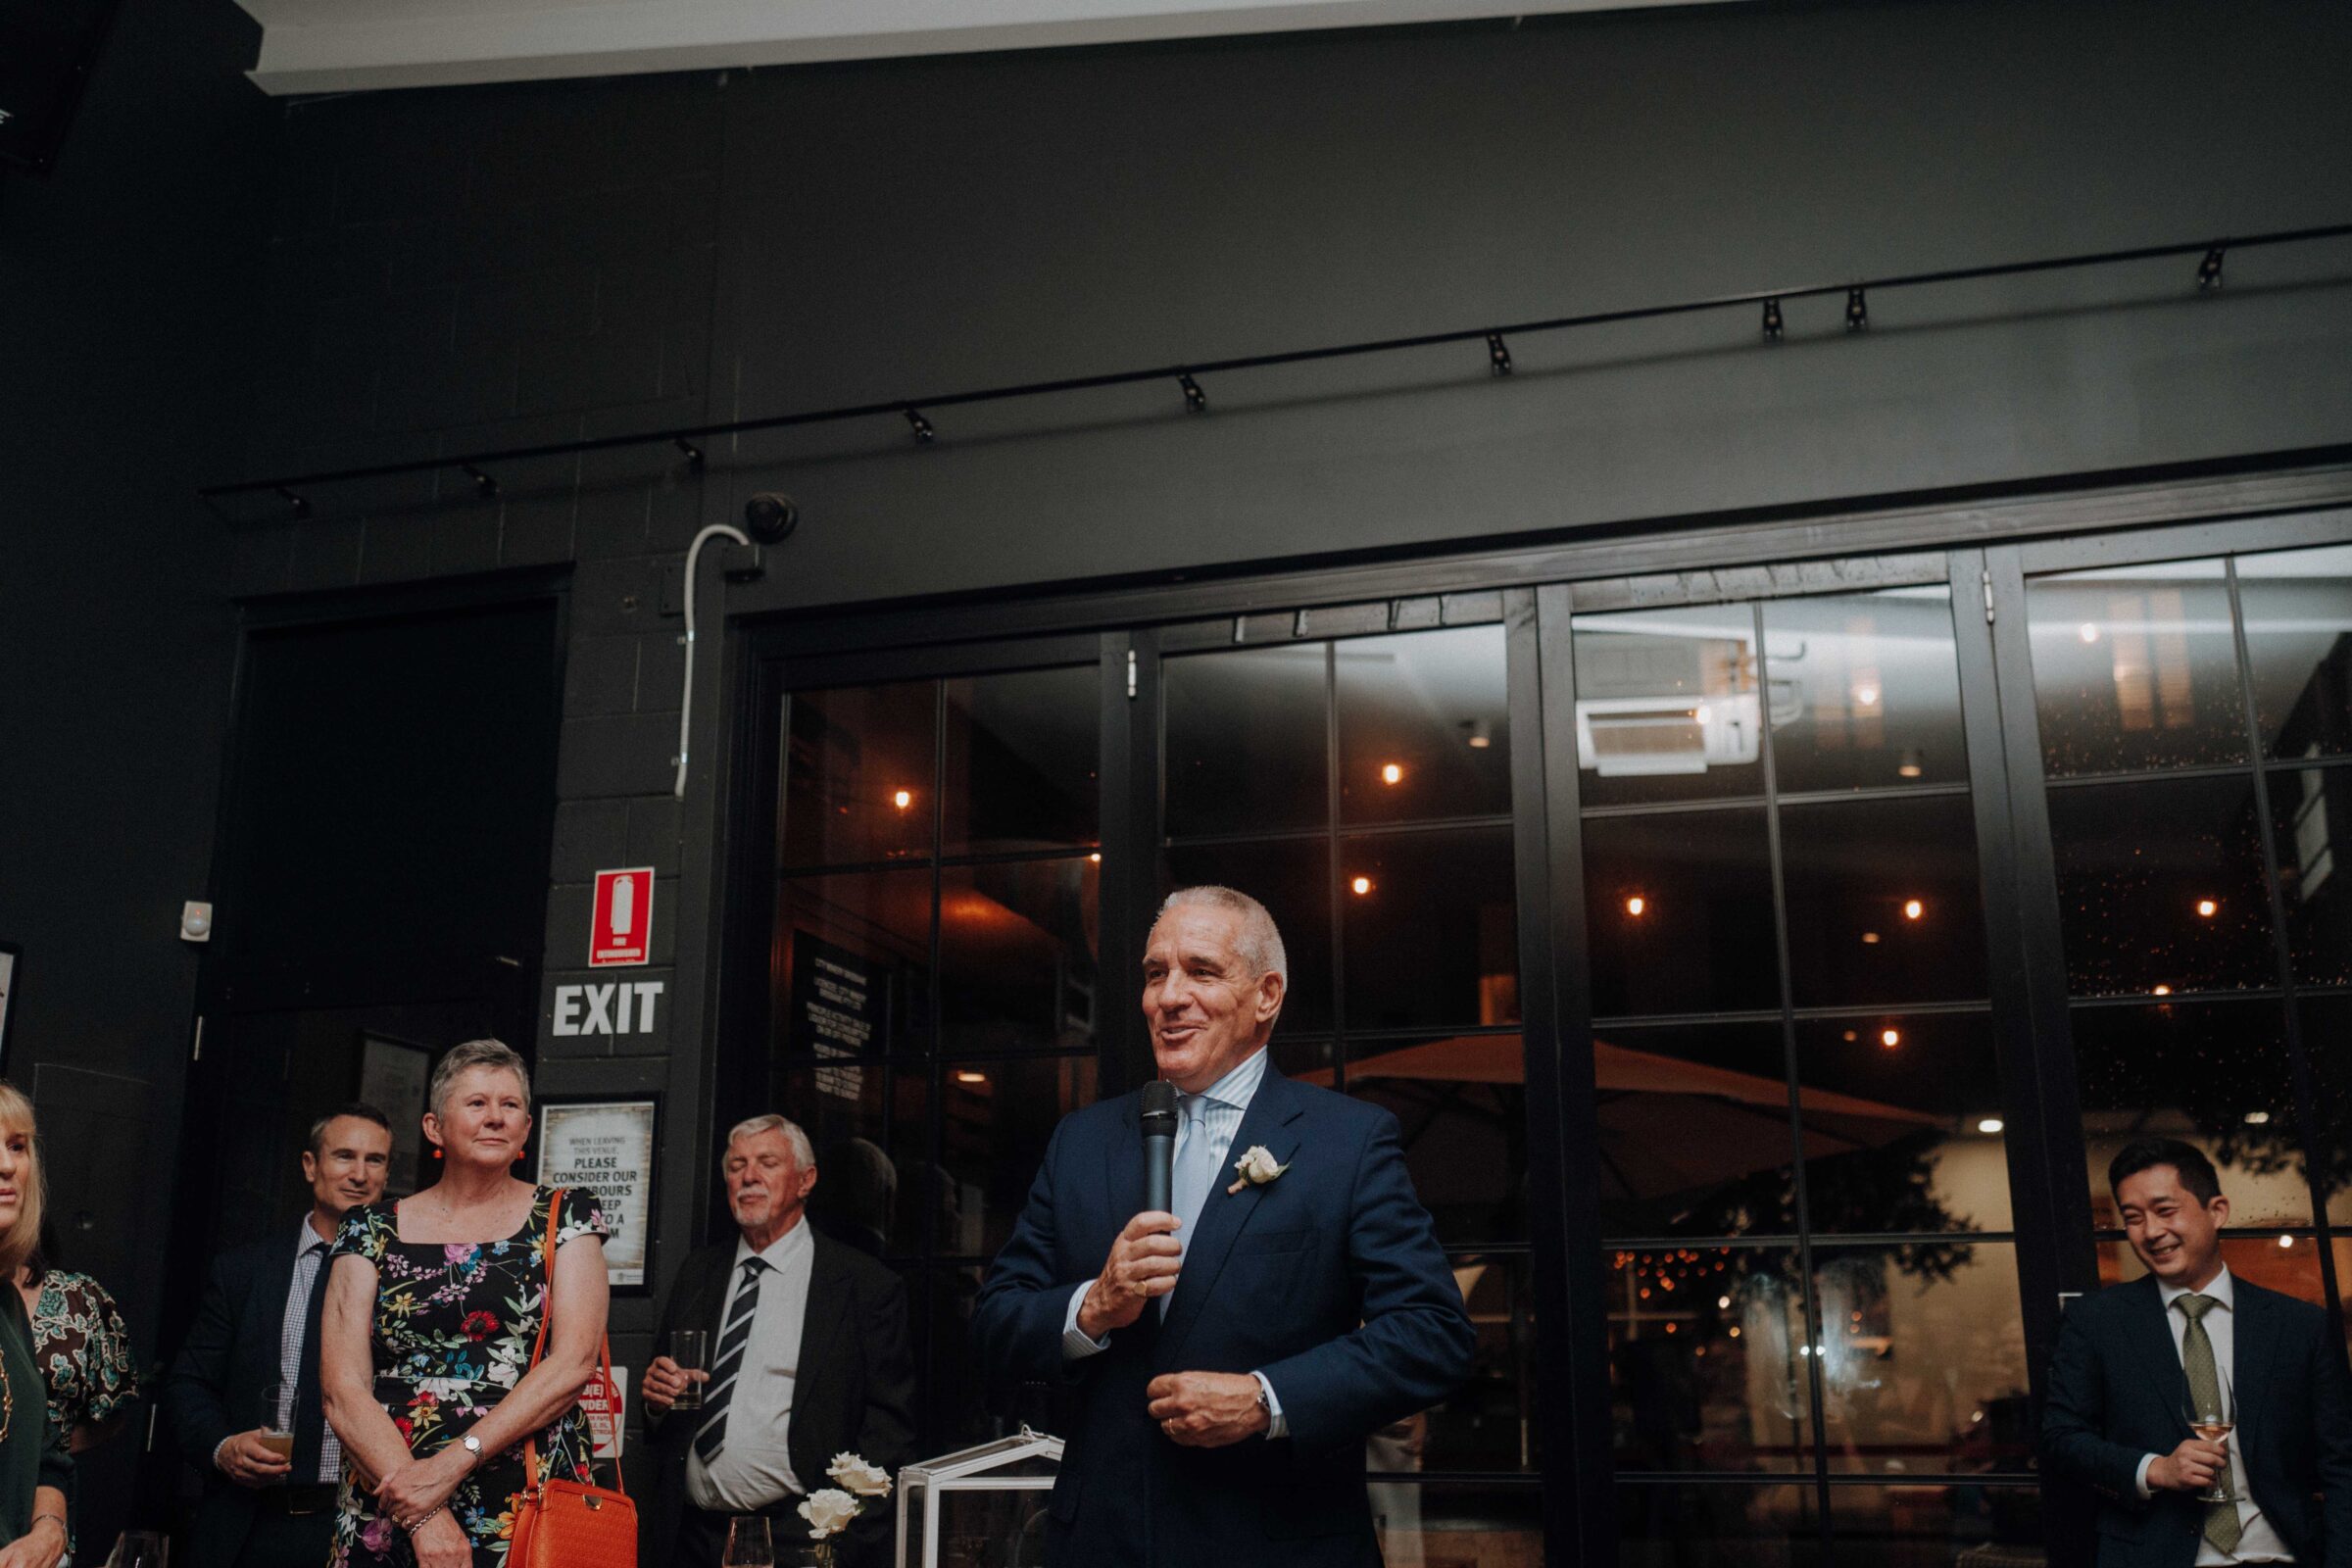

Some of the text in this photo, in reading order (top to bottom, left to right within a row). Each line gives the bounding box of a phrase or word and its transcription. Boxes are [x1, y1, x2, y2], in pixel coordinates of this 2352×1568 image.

[553, 981, 664, 1037] EXIT
[569, 1136, 625, 1146] WHEN LEAVING
[573, 1147, 591, 1155] THIS
[574, 1156, 617, 1168] PLEASE
[553, 1170, 637, 1183] CONSIDER OUR
[601, 1200, 621, 1210] EEP
[616, 1213, 624, 1225] A
